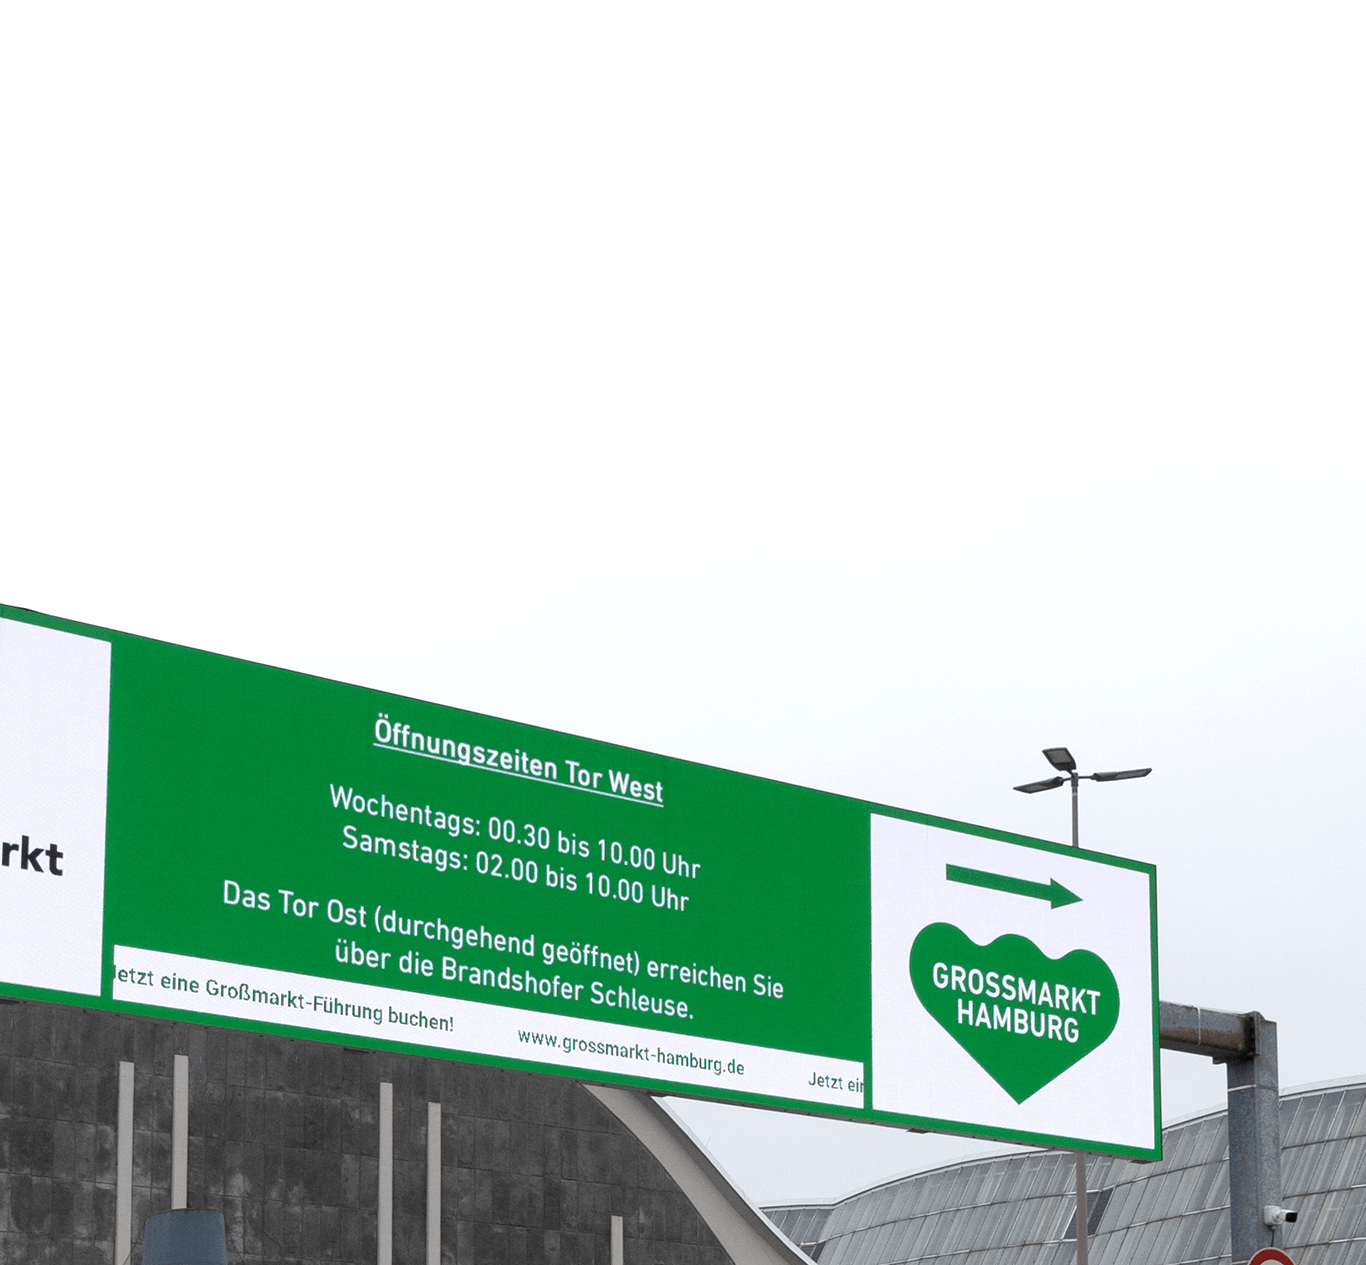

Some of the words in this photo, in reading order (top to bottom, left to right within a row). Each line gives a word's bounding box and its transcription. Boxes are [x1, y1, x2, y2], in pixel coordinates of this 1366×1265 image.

[374, 713, 557, 779] Öffnungszeiten
[566, 760, 602, 789] Tor
[608, 770, 663, 803] West
[330, 784, 481, 837] Wochentags:
[489, 817, 550, 849] 00.30
[558, 830, 589, 858] bis
[598, 839, 655, 870] 10.00
[663, 852, 700, 879] Uhr
[342, 825, 468, 871] Samstags:
[476, 851, 538, 883] 02.00
[546, 865, 577, 891] bis
[586, 873, 643, 903] 10.00
[651, 885, 688, 912] Uhr
[223, 880, 271, 911] Das
[279, 889, 319, 919] Tor
[327, 898, 367, 928] Ost
[375, 904, 535, 956] (durchgehend
[542, 934, 639, 976] geöffnet)
[647, 957, 747, 994] erreichen
[753, 974, 784, 999] Sie
[160, 973, 200, 993] eine
[206, 979, 383, 1024] Großmarkt-Führung
[388, 1006, 454, 1032] buchen!
[336, 938, 390, 969] über
[398, 950, 434, 976] die
[442, 956, 584, 1001] Brandshofer
[590, 981, 694, 1020] Schleuse.
[932, 961, 1101, 1016] GROSSMARKT
[518, 1029, 745, 1076] www.grossmarkt-hamburg.de
[957, 998, 1080, 1043] HAMBURG
[808, 1072, 843, 1091] Jetzt
